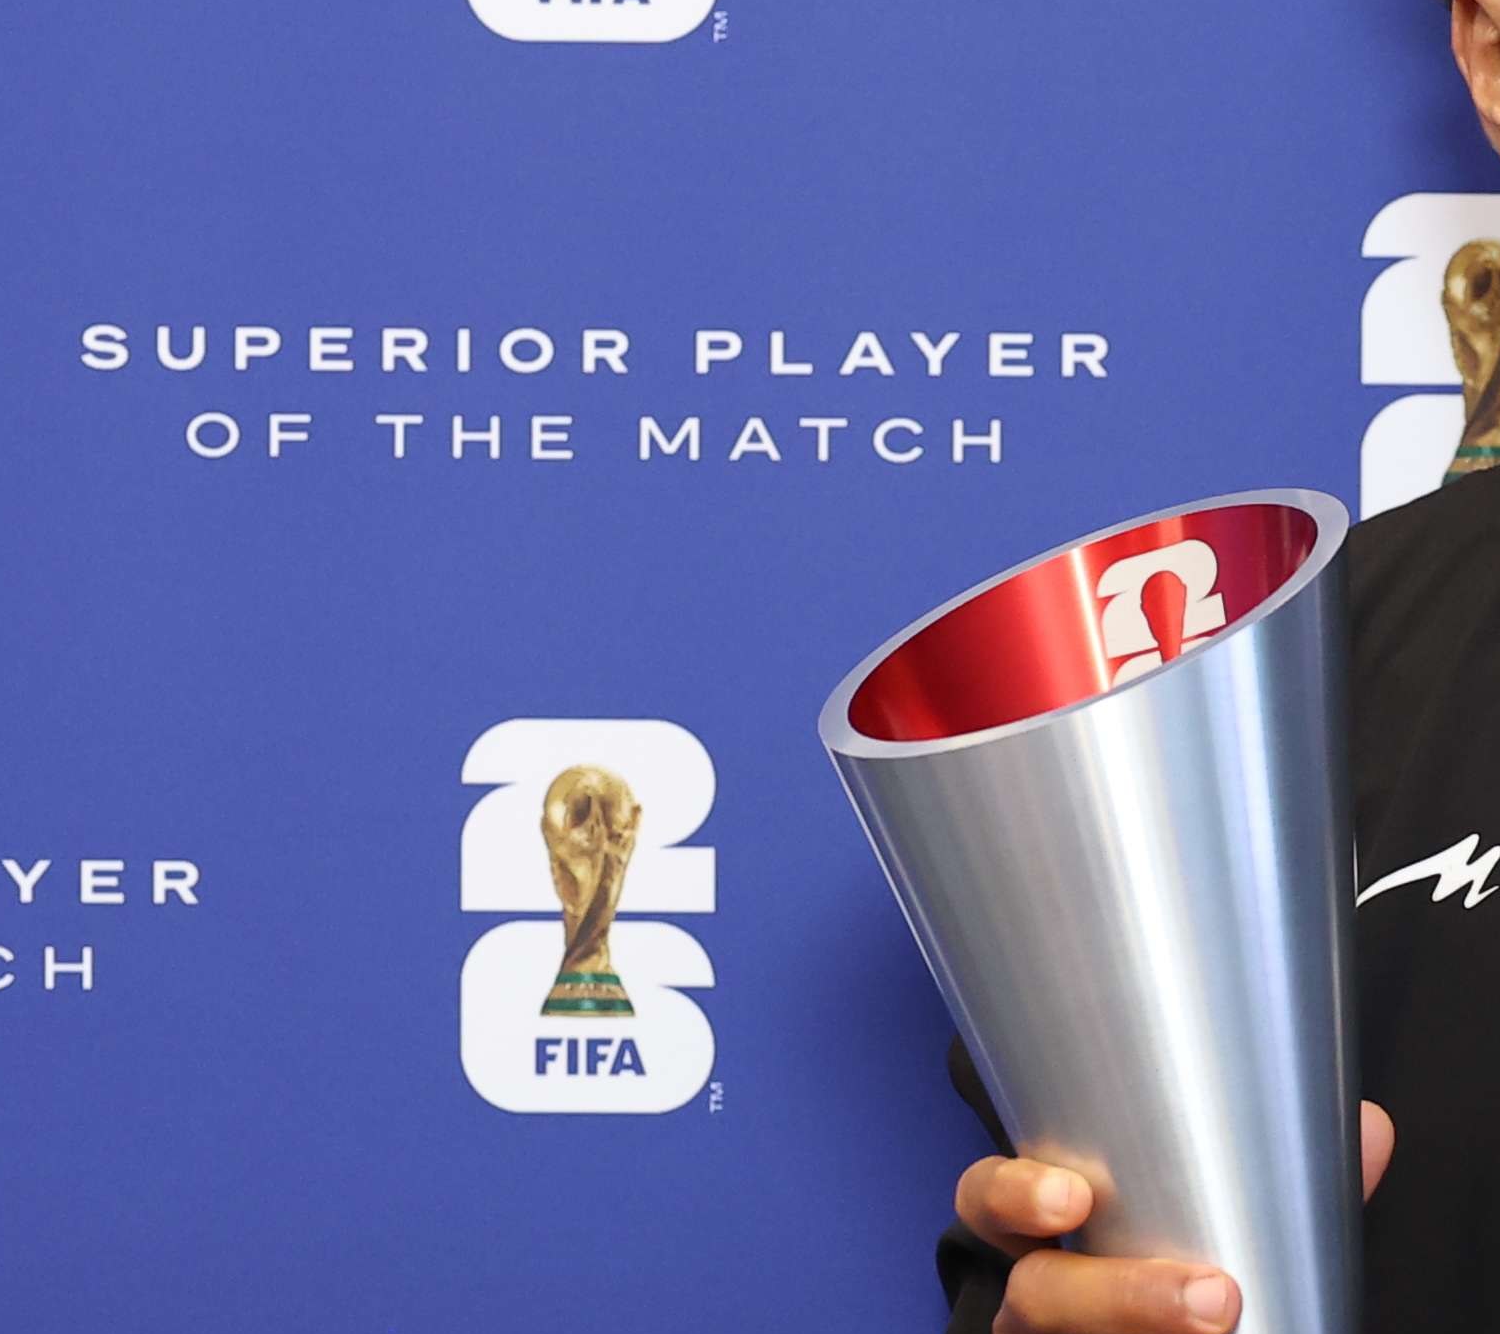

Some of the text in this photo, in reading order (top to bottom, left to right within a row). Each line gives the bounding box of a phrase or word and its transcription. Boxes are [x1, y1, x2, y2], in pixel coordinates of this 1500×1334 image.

[80, 324, 1109, 378] SUPERIOR PLAYER
[186, 412, 1002, 464] OF THE MATCH
[535, 1038, 645, 1076] FIFA
